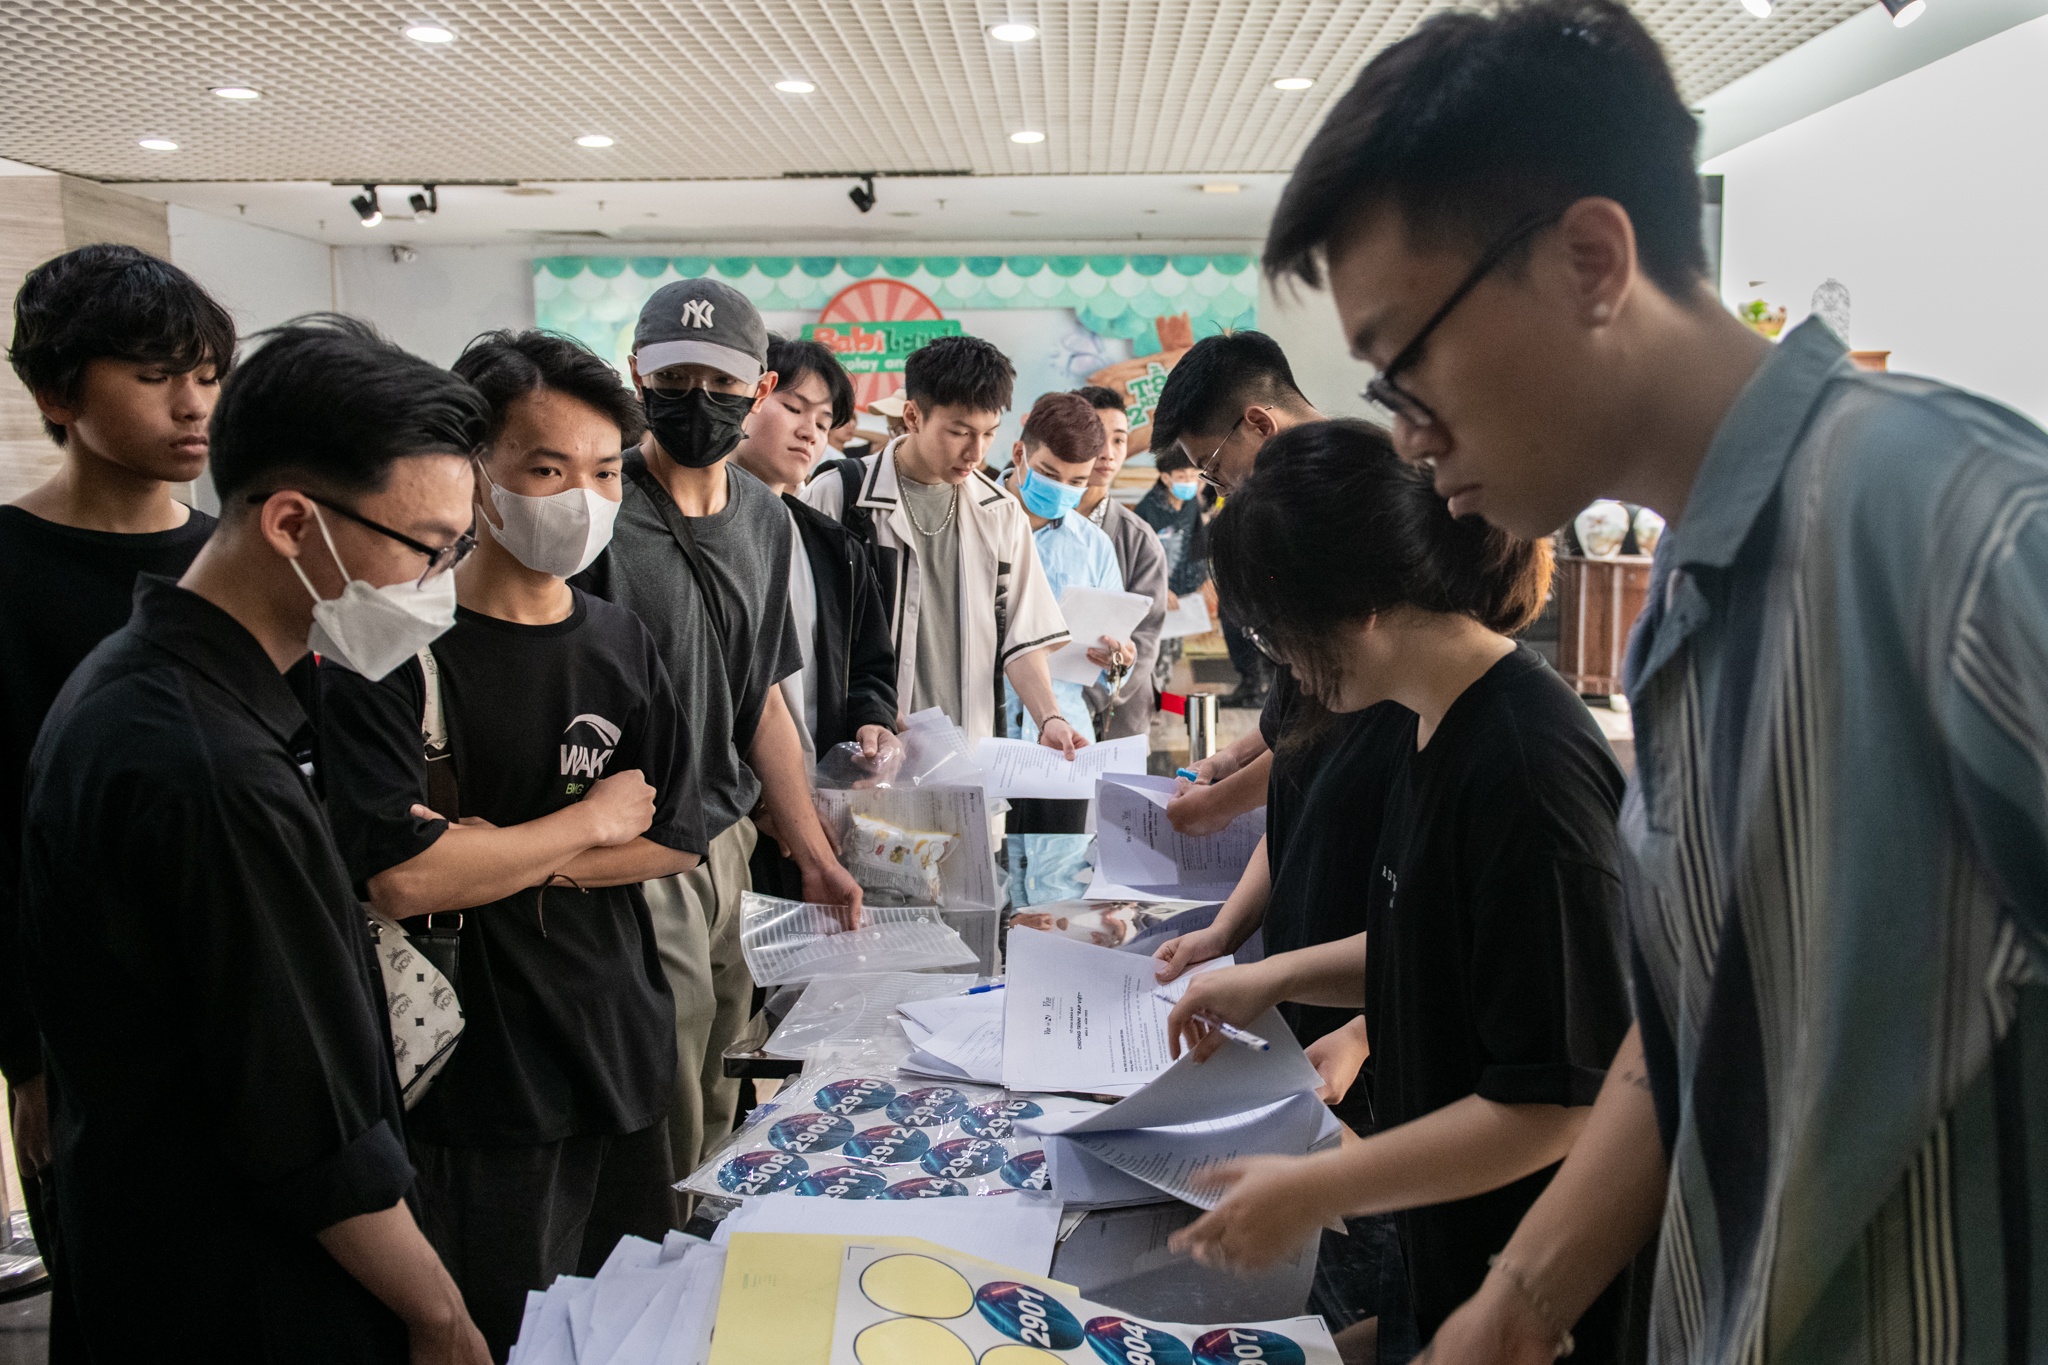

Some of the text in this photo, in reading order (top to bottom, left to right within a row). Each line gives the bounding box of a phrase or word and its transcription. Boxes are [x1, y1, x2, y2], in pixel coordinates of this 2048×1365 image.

[680, 299, 715, 329] NY
[560, 743, 615, 778] WAK
[830, 1079, 882, 1115] 2910
[904, 1087, 953, 1126] 2913
[785, 1114, 840, 1152] 2909
[980, 1100, 1028, 1139] 2916
[861, 1126, 916, 1166] 2912
[940, 1139, 992, 1177] 2915
[735, 1153, 795, 1195] 2908
[917, 1179, 954, 1197] 14
[1017, 1286, 1051, 1348] 2901
[1123, 1320, 1155, 1365] 904
